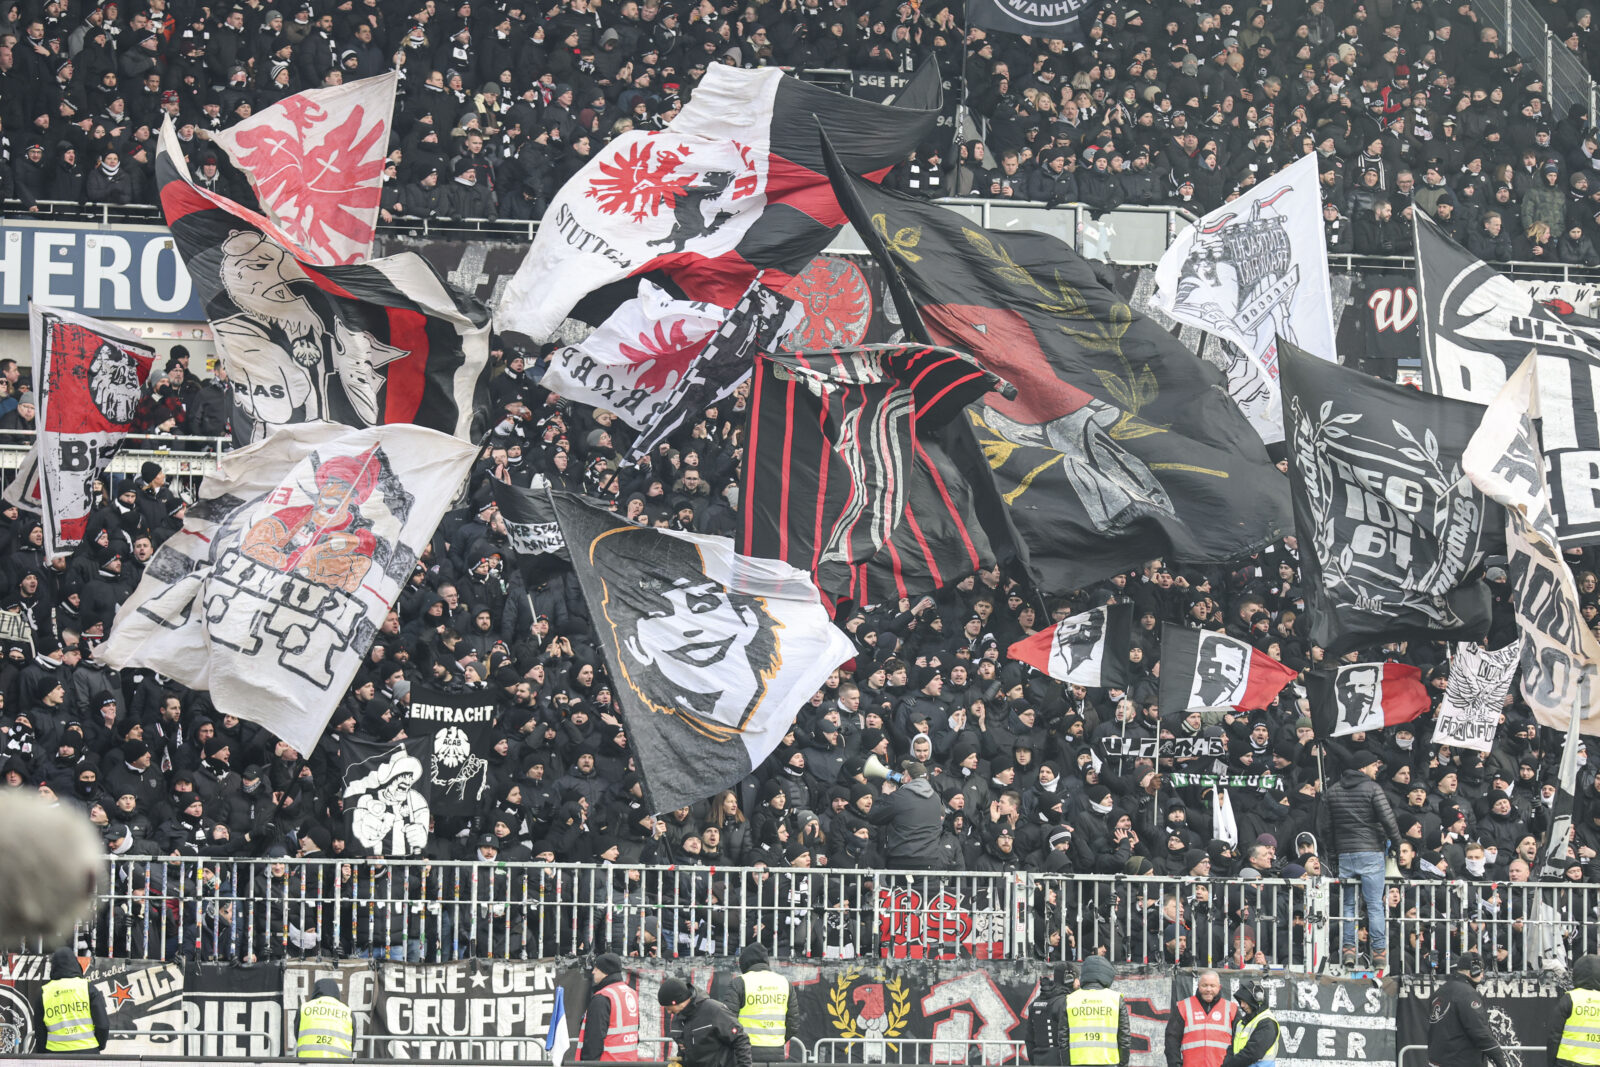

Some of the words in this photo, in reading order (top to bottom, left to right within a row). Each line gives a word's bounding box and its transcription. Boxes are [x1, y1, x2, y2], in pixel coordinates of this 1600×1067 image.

[859, 75, 886, 88] SGE
[1351, 524, 1414, 570] 64
[411, 703, 494, 722] EINTRACHT
[385, 962, 467, 994] EHRE
[492, 961, 556, 994] DER
[747, 994, 787, 1005] ORDNER
[46, 1001, 89, 1018] ORDNER
[304, 1006, 348, 1020] ORDNER
[386, 994, 556, 1037] GRUPPE
[1071, 1006, 1113, 1017] ORDNER
[316, 1035, 332, 1045] 262
[1084, 1032, 1101, 1041] 199
[1280, 1025, 1367, 1059] VER
